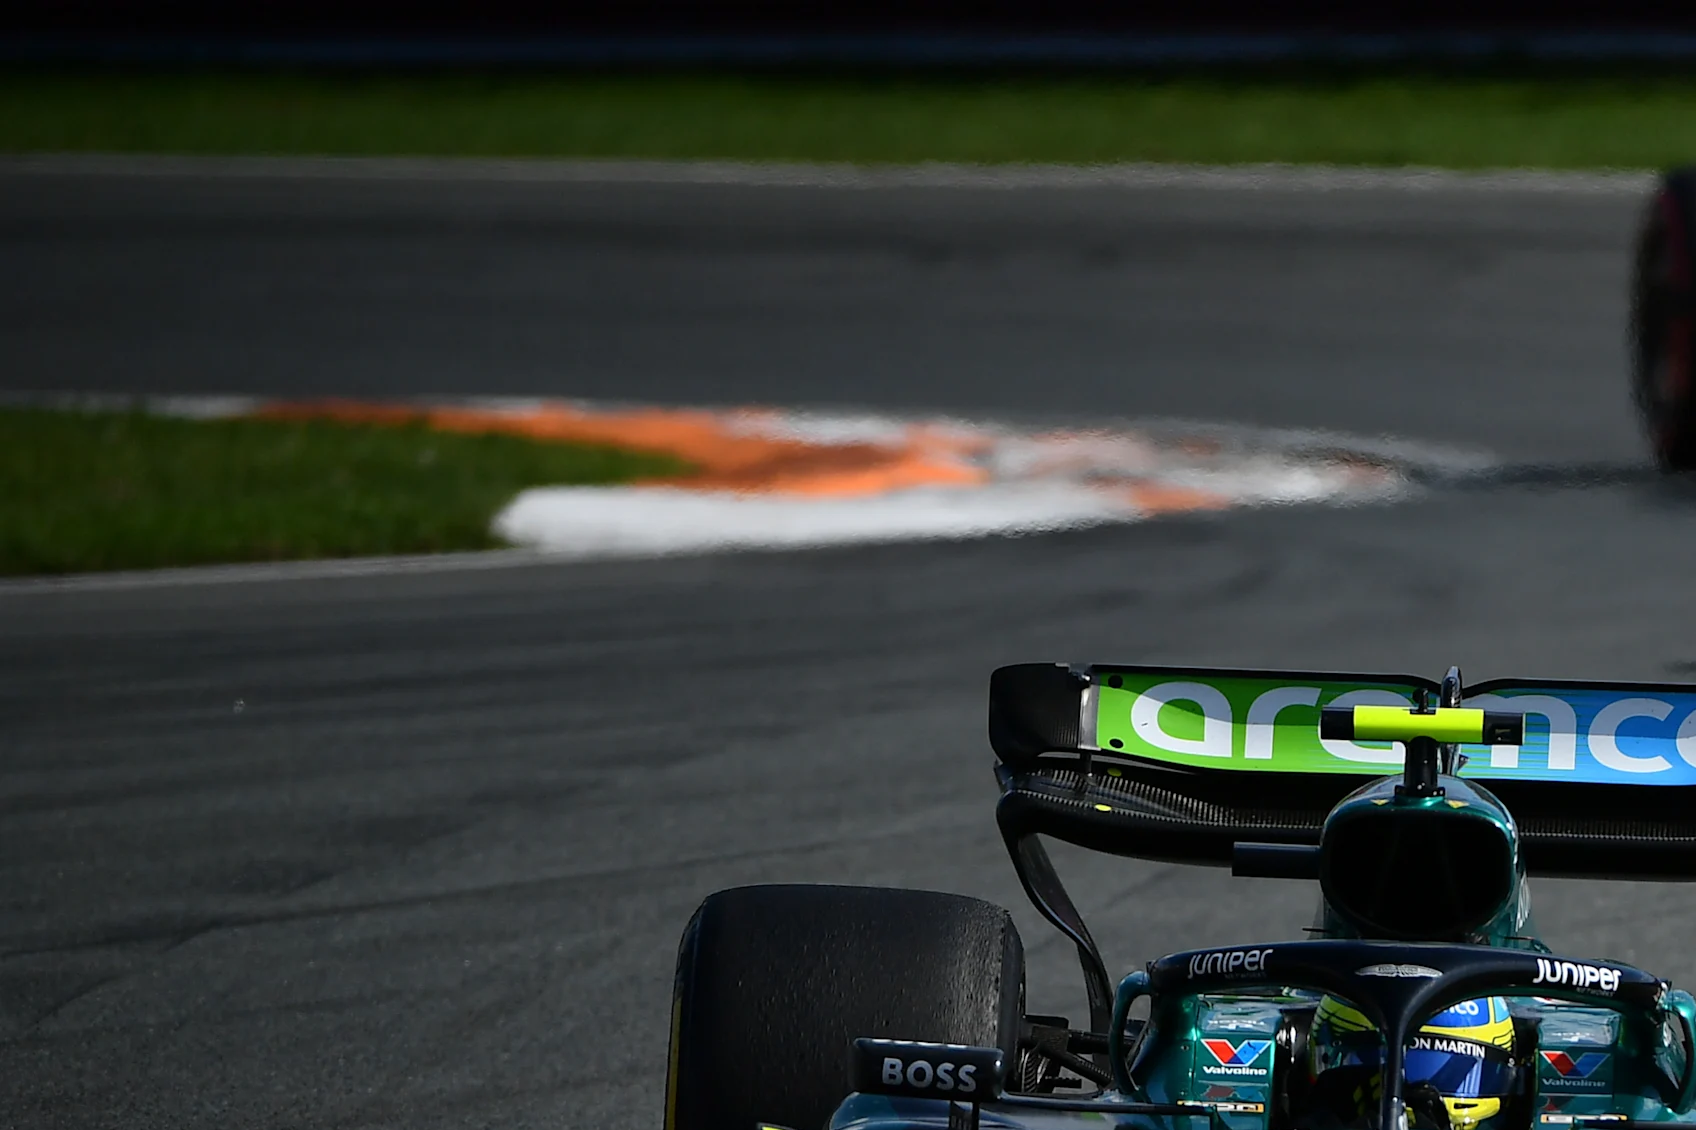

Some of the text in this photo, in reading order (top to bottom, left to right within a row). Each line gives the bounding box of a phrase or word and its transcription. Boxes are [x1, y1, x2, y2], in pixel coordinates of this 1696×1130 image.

[1434, 1039, 1485, 1058] MARTIN
[882, 1057, 977, 1092] BOSS
[1202, 1065, 1267, 1076] Valvoline
